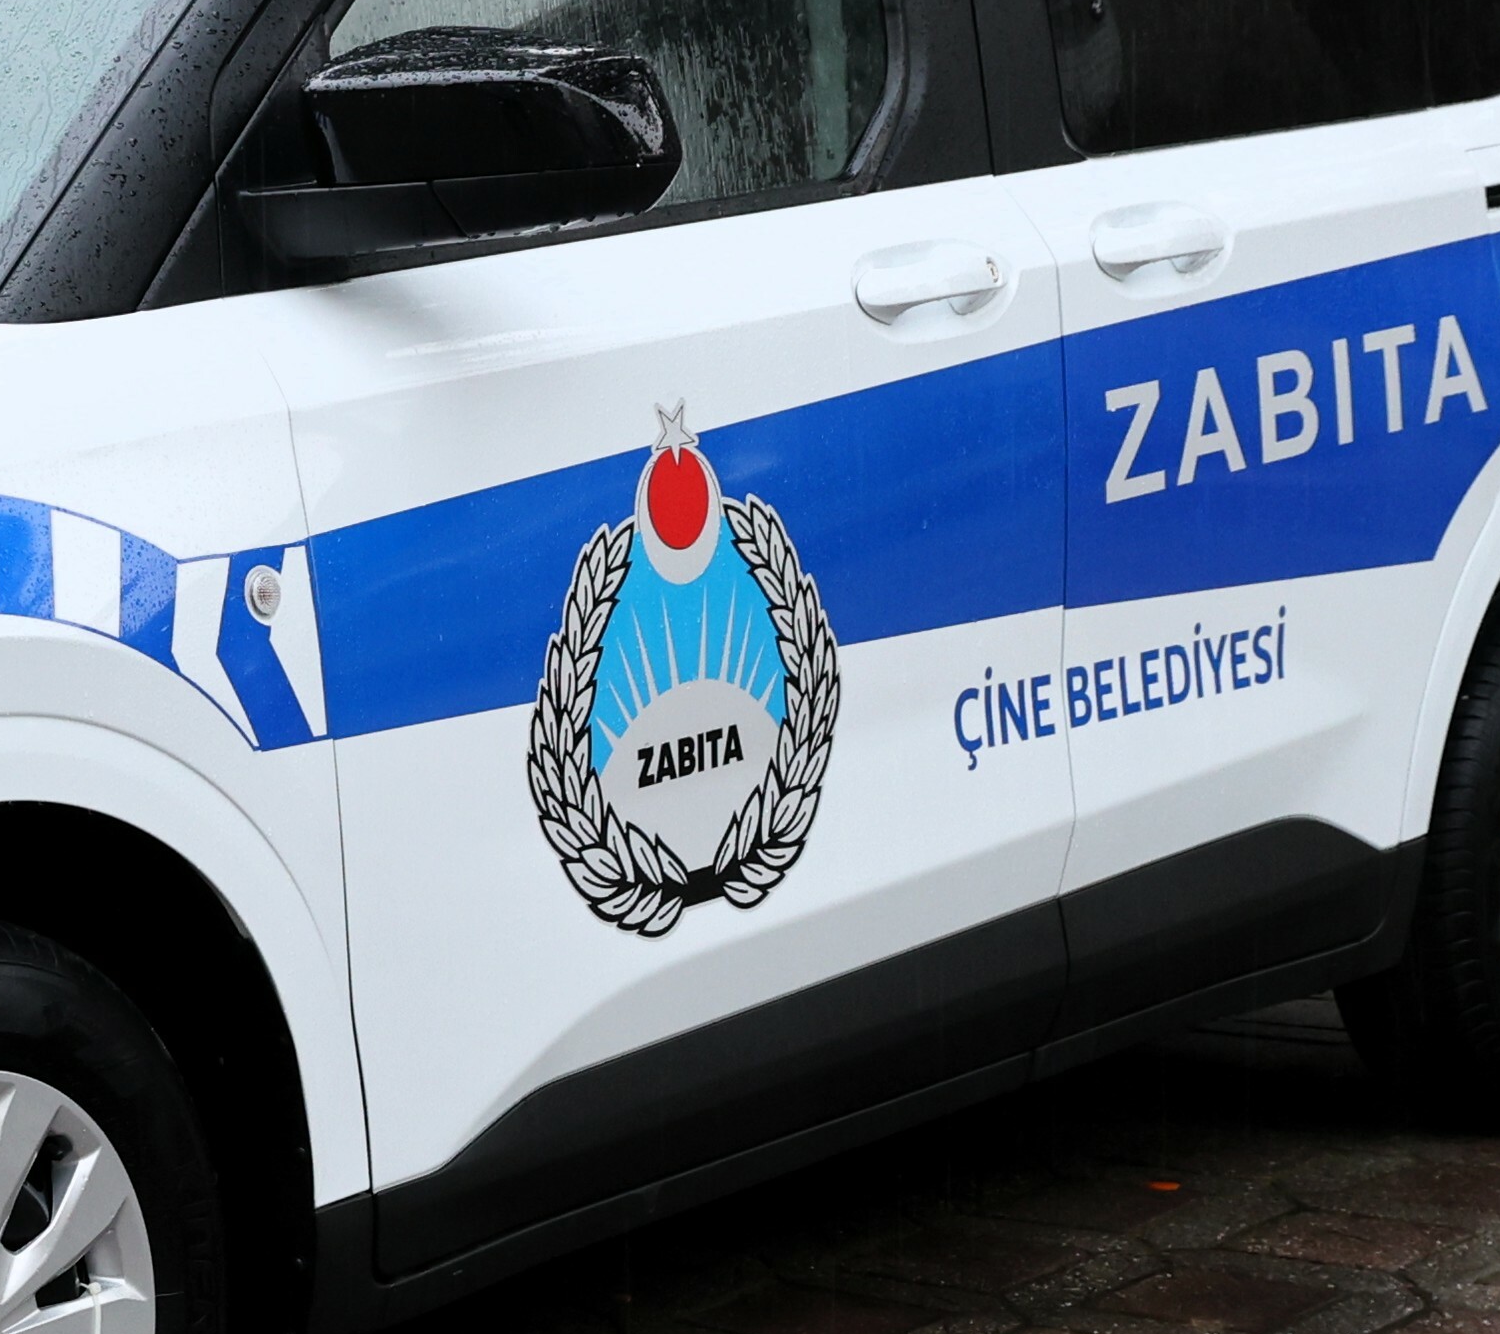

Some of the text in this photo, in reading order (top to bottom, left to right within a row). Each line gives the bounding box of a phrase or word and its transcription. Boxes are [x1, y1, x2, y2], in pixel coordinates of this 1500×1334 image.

[1104, 314, 1489, 506] ZABITA
[636, 725, 744, 789] ZABITA
[953, 605, 1287, 771] ÇİNE BELEDİYESİ
